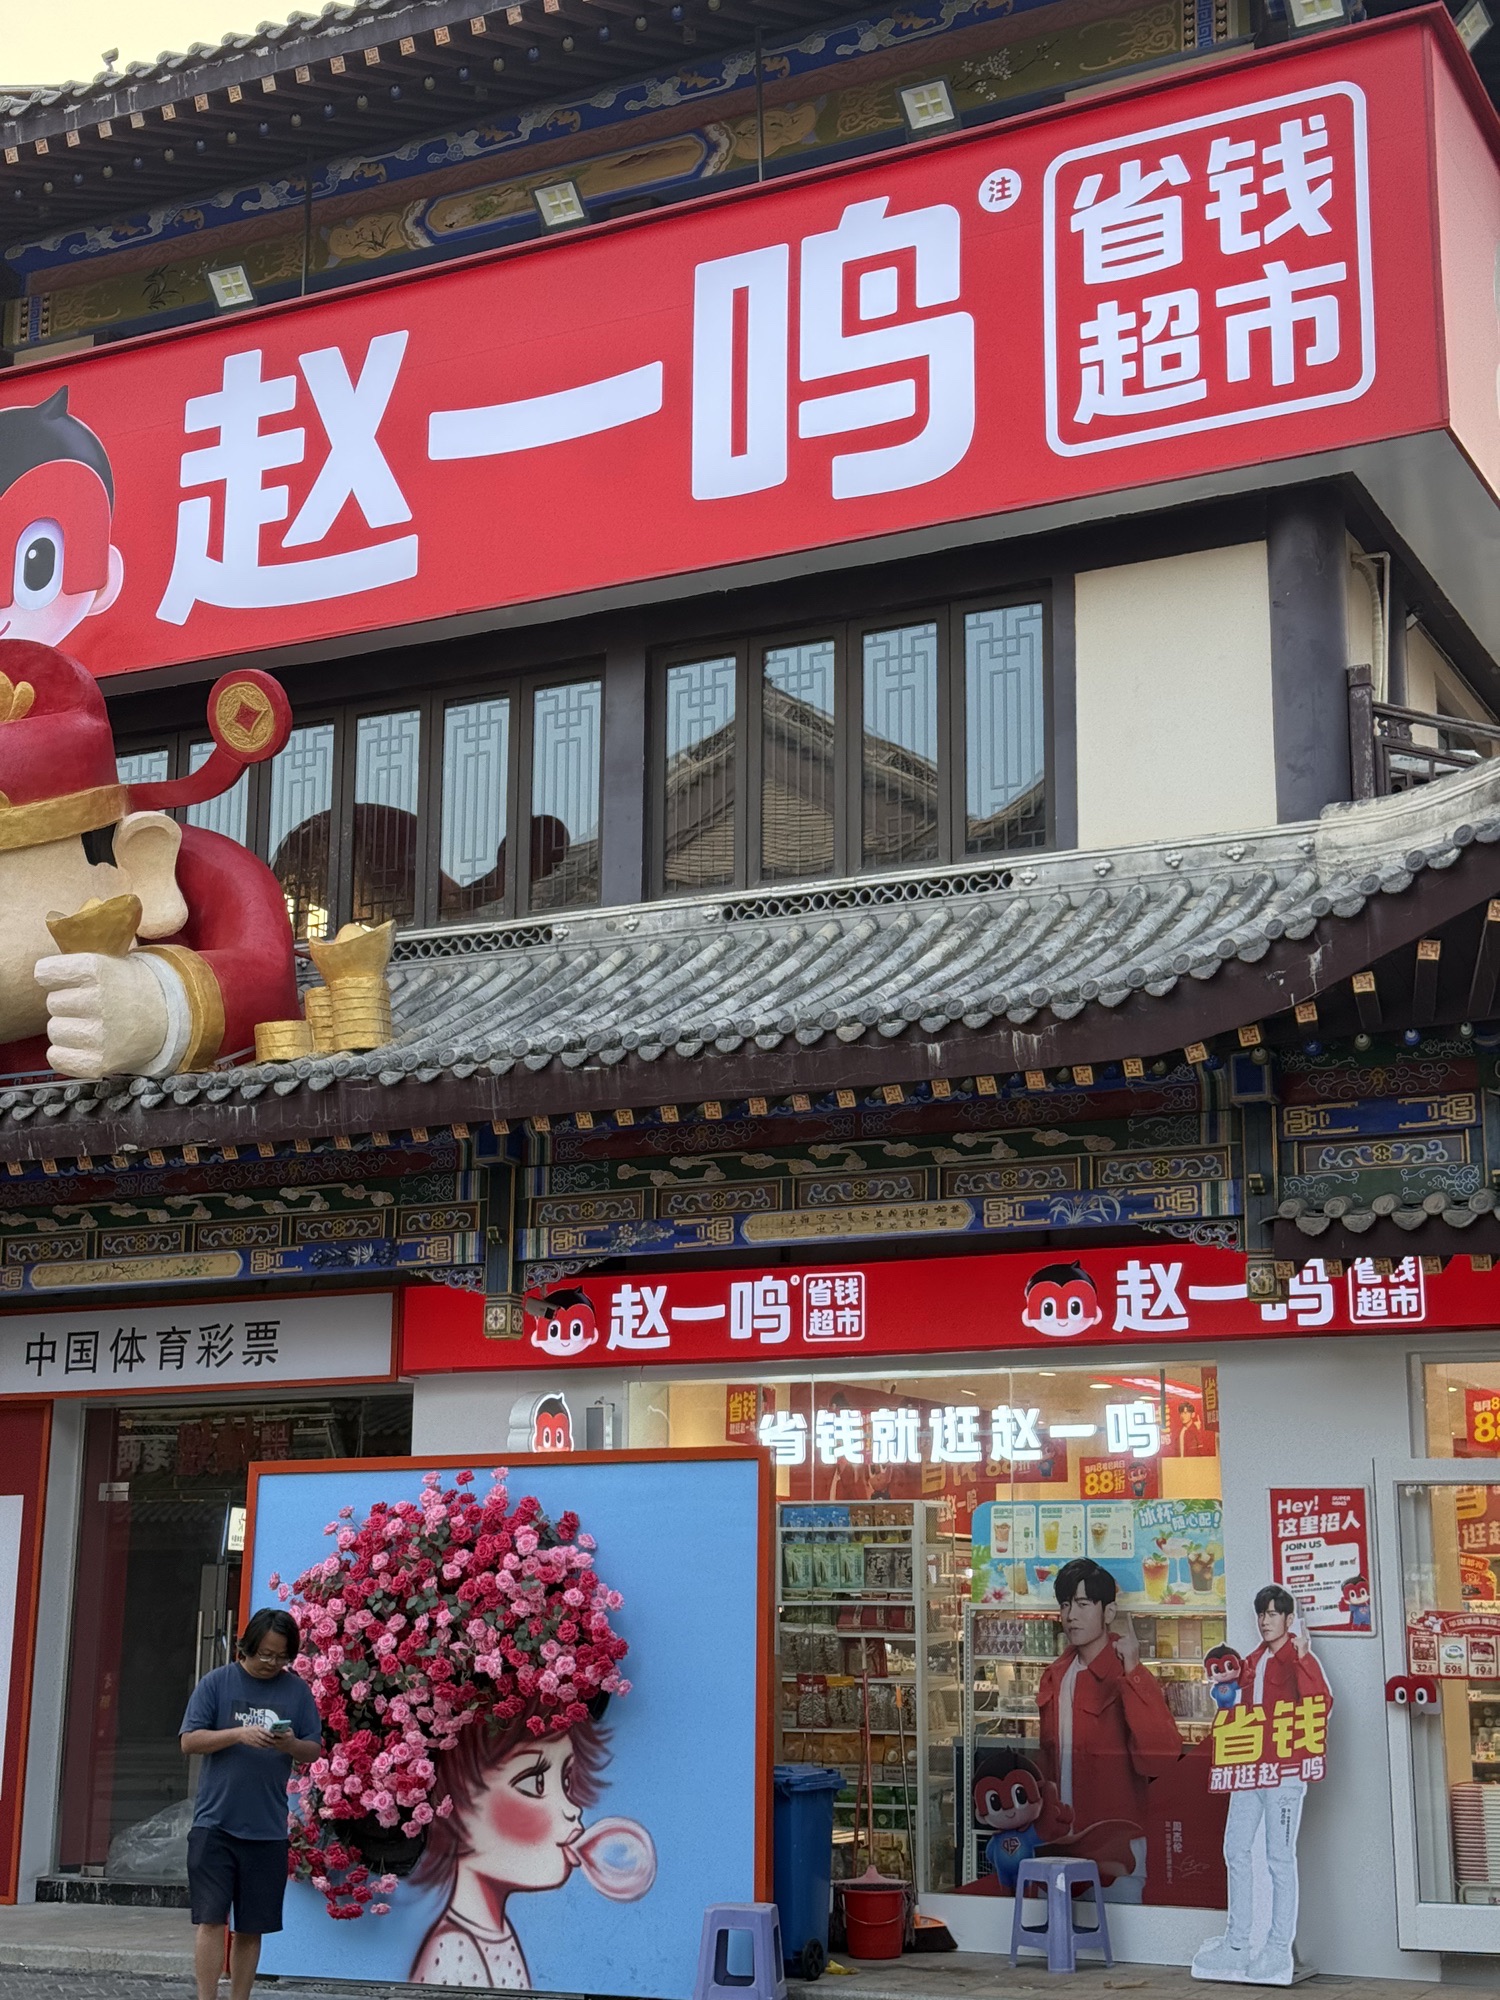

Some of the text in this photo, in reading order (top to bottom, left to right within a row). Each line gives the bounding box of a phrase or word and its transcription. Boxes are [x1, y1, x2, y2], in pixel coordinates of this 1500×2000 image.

[987, 176, 1012, 204] 注
[1070, 113, 1333, 286] 省钱
[1073, 260, 1347, 425] 超市
[157, 196, 975, 626] 赵一鸣
[808, 1277, 860, 1306] 省钱
[1356, 1285, 1419, 1317] 超市
[606, 1275, 791, 1351] 赵一鸣
[808, 1307, 861, 1336] 超市
[24, 1319, 283, 1378] 中国体育彩票
[758, 1399, 1160, 1465] 省钱就逛赵一鸣
[1277, 1495, 1319, 1516] Hey!
[1277, 1510, 1361, 1538] 这里招人
[1285, 1540, 1322, 1552] JOIN US
[249, 1707, 265, 1717] THE
[1213, 1695, 1327, 1766] 省钱
[1210, 1757, 1324, 1790] 就逛赵一鸣
